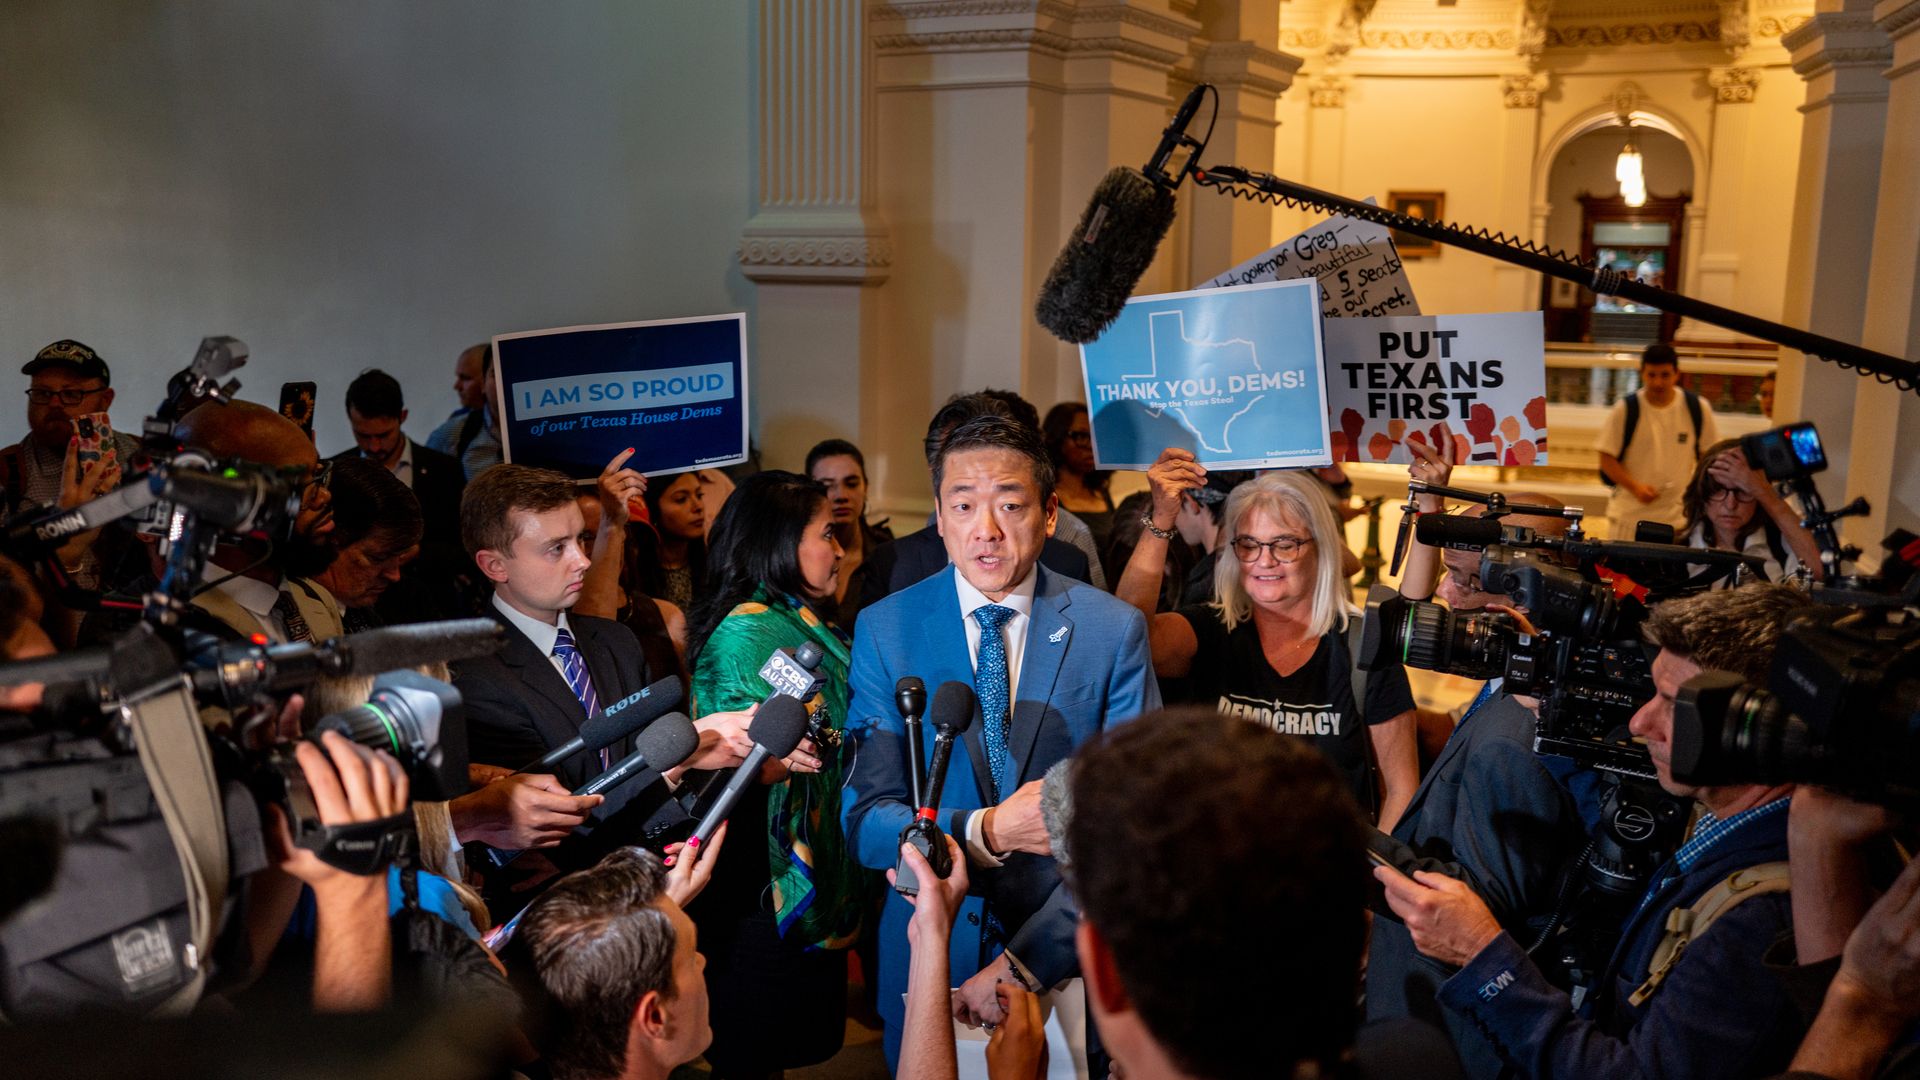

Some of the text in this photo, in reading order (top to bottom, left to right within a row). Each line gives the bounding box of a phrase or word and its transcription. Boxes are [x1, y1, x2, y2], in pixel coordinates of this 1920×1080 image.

[1344, 289, 1369, 312] our
[1379, 330, 1458, 359] PUT
[1096, 369, 1306, 401] THANK YOU, DEMS!
[1341, 360, 1504, 389] TEXANS
[524, 373, 724, 409] I AM SO PROUD
[1149, 395, 1234, 411] Stop the Texas Steal
[1367, 392, 1477, 420] FIRST
[530, 406, 723, 437] of our Texas House Dems
[35, 511, 88, 540] RONIN
[762, 667, 801, 699] AUSTIN
[781, 664, 809, 690] CBS
[604, 686, 651, 718] RØDE
[1217, 696, 1342, 736] DEMOCRACY
